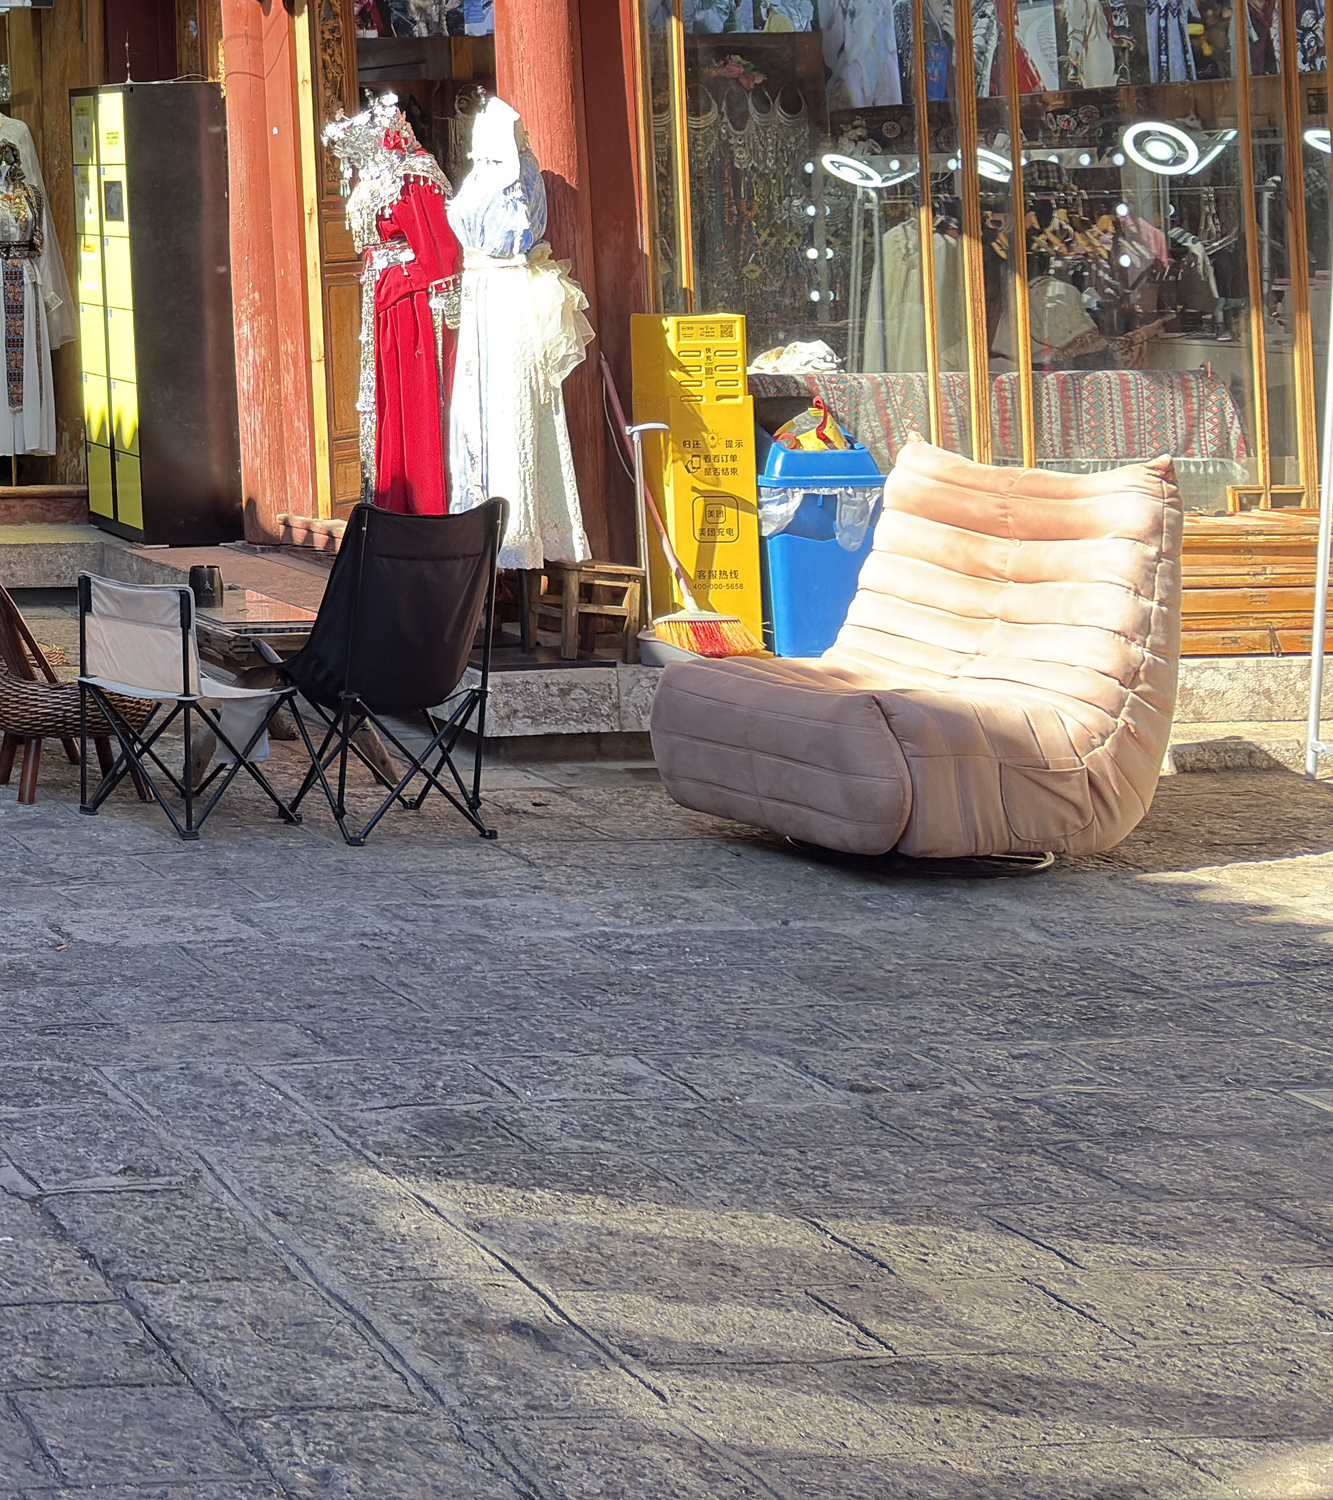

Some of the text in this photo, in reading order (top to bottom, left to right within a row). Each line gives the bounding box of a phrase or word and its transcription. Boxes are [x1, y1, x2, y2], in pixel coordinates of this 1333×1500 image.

[682, 439, 744, 449] 归还 提示
[704, 454, 738, 463] 看看订单
[704, 467, 739, 476] 是否结束
[707, 509, 724, 518] 美团
[699, 527, 735, 537] 美团充电
[696, 569, 740, 580] 客服热线
